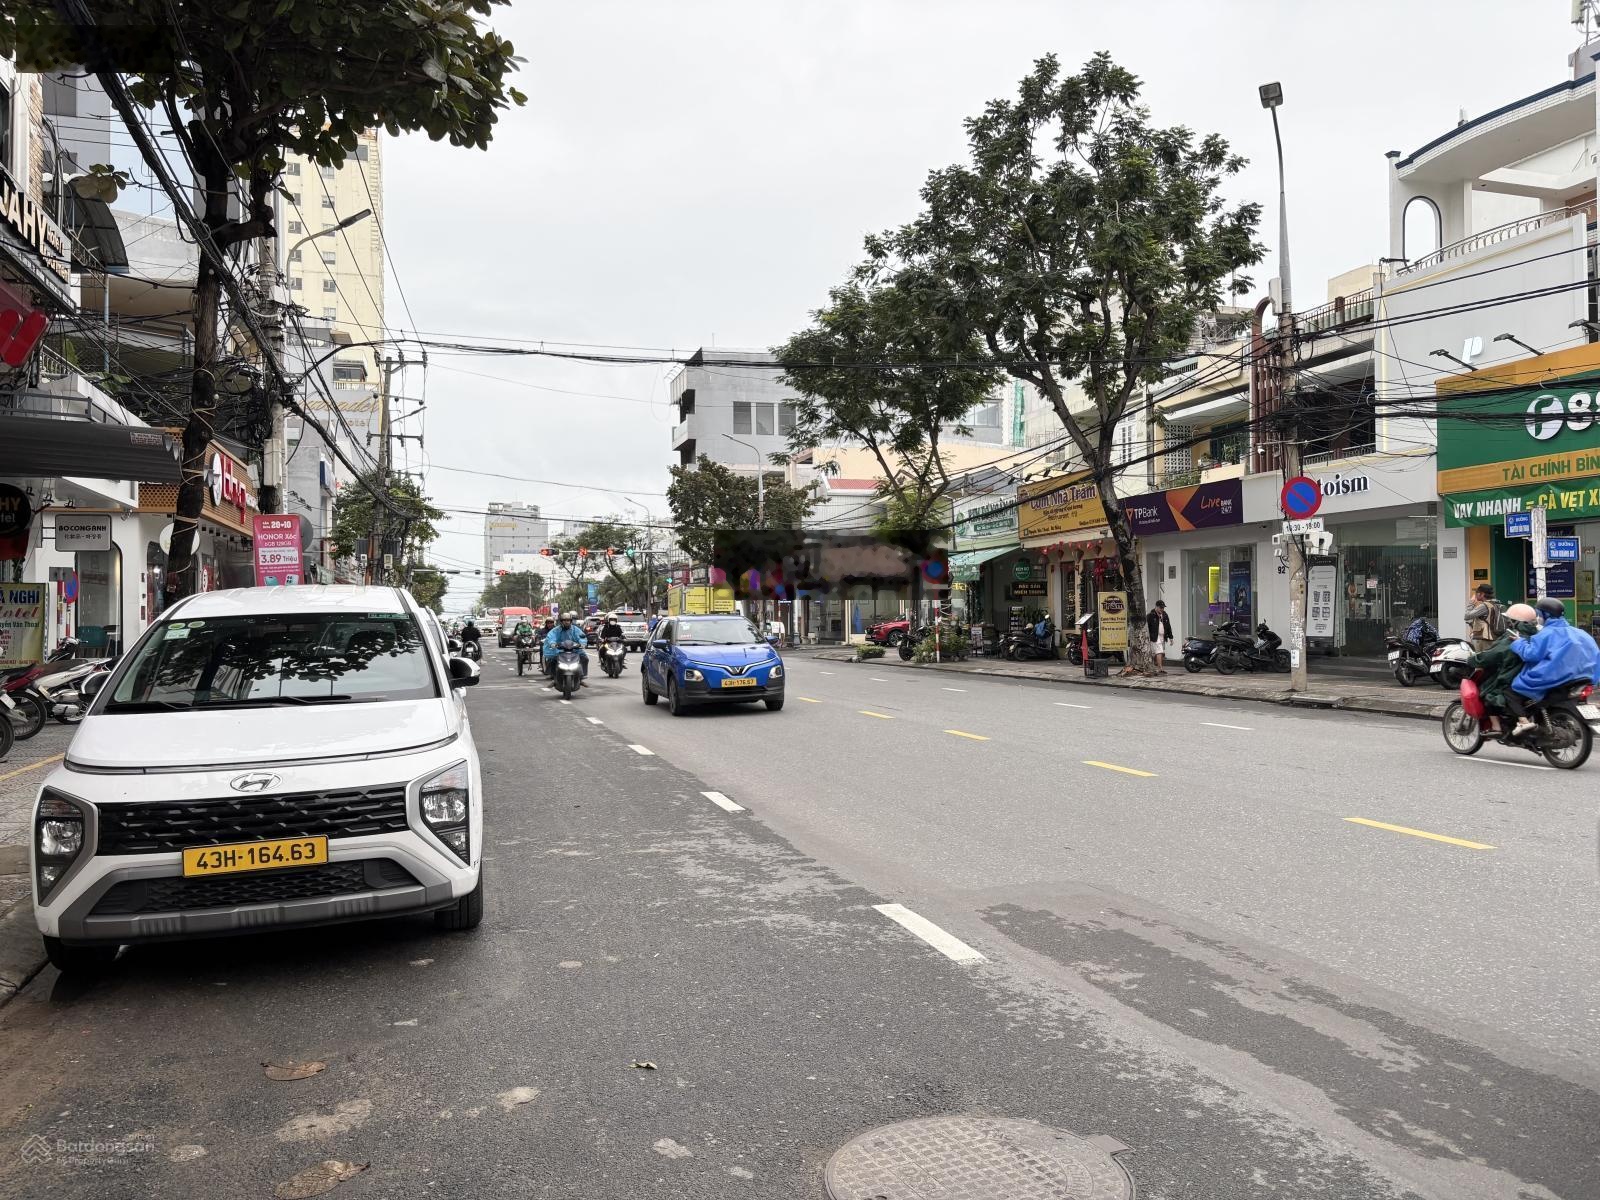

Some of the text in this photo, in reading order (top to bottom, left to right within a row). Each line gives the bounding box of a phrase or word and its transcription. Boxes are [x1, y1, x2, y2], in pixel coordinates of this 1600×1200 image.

[1502, 464, 1525, 481] TÀI
[1529, 459, 1571, 478] CHÍNH
[1134, 506, 1158, 519] TPBank
[1453, 502, 1474, 519] VAY
[1476, 498, 1522, 517] NHANH
[1538, 490, 1557, 510] CÀ
[1560, 490, 1586, 511] VẸT
[261, 554, 282, 563] 3.89
[1278, 566, 1286, 574] 92
[196, 842, 316, 870] 43H-164.63
